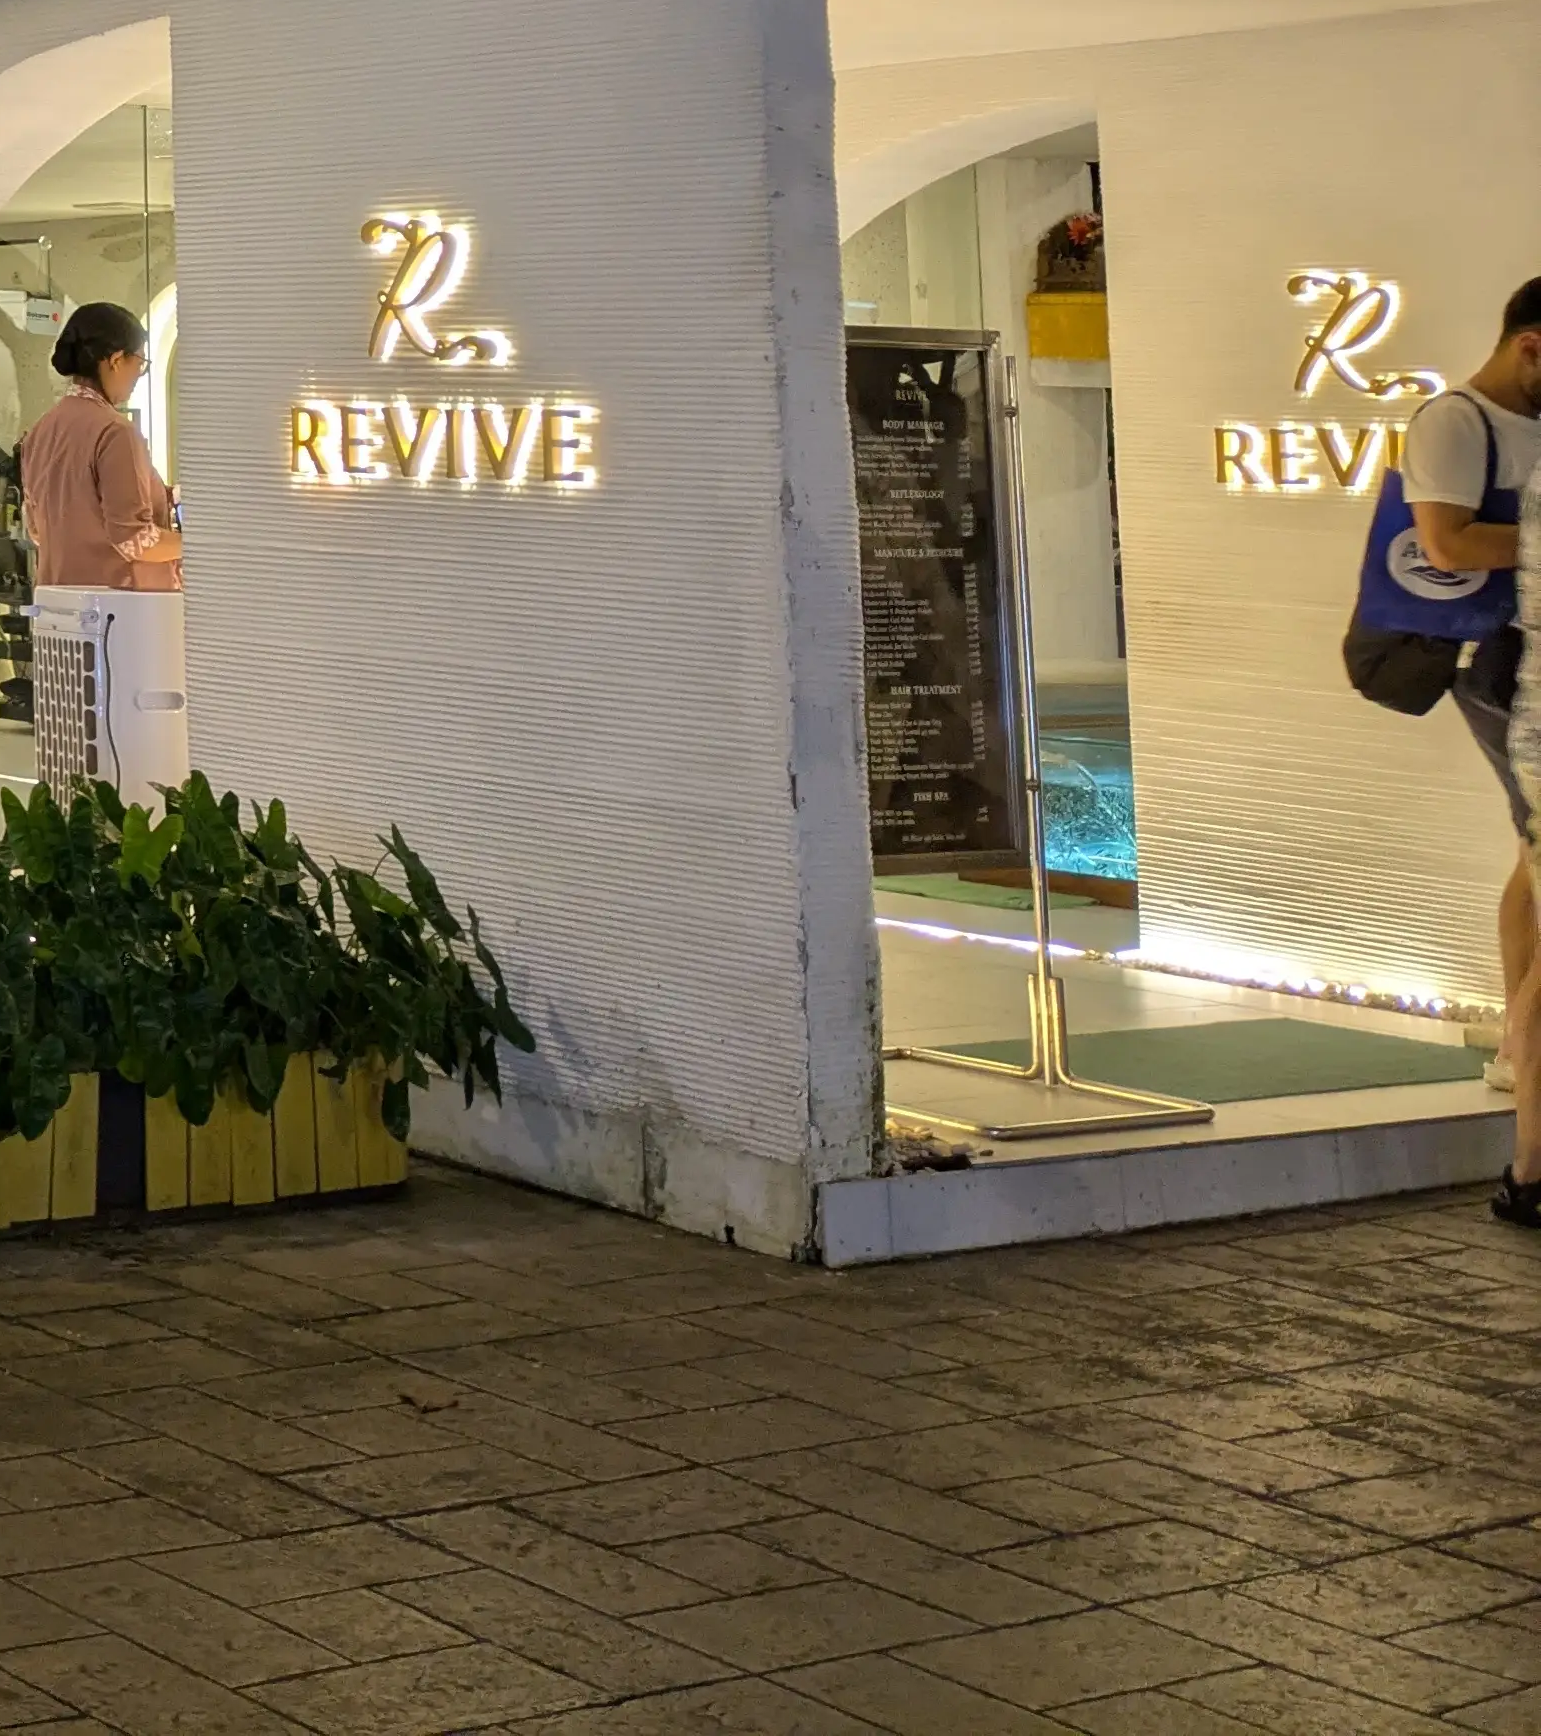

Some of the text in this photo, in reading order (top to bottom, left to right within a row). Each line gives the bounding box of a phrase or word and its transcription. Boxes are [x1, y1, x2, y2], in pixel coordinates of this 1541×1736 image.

[360, 216, 501, 360] R
[1286, 273, 1443, 398] R
[883, 420, 904, 430] BODY
[895, 390, 928, 401] REVIVE
[289, 405, 587, 483] REVIVE
[1214, 426, 1407, 488] REVI
[890, 685, 963, 696] HAIR TREATMENT
